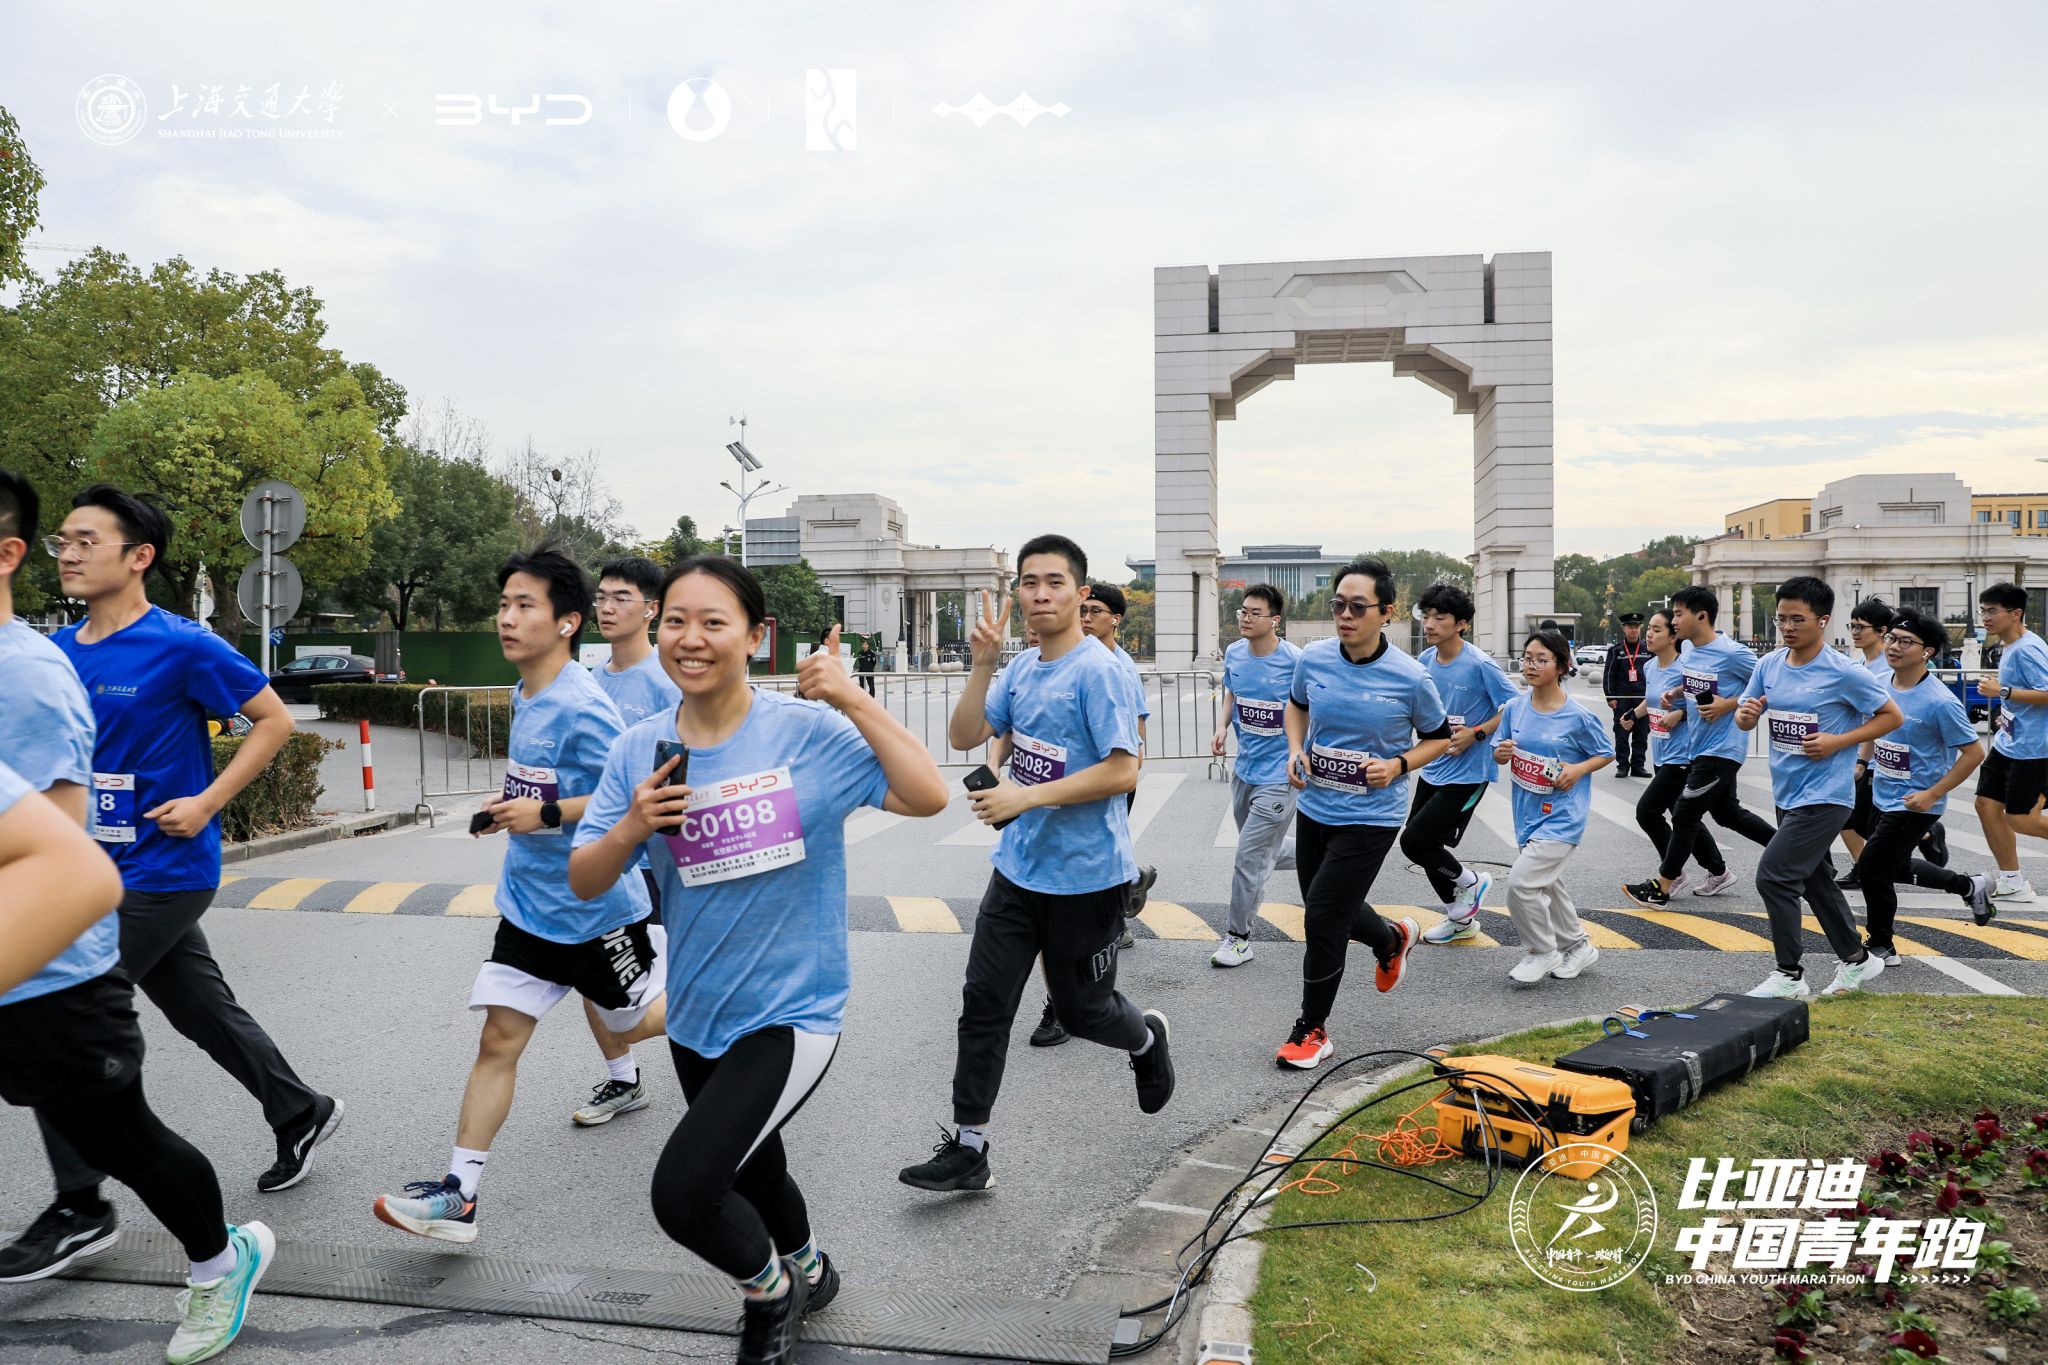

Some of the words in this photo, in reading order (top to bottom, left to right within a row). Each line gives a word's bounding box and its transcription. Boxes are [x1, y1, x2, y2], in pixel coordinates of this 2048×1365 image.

[1686, 678, 1710, 690] E0099
[1051, 692, 1075, 700] BYD
[1242, 707, 1275, 721] E0164
[1788, 713, 1812, 722] BYD
[1772, 721, 1807, 736] E0188
[1032, 741, 1059, 757] BYD
[1333, 750, 1363, 760] BYD
[1013, 747, 1053, 779] E0082
[1311, 753, 1358, 775] E0029
[1513, 757, 1543, 776] G002
[519, 767, 548, 780] BYD
[94, 777, 125, 787] YD
[720, 774, 778, 798] BYD
[681, 799, 777, 842] C0198
